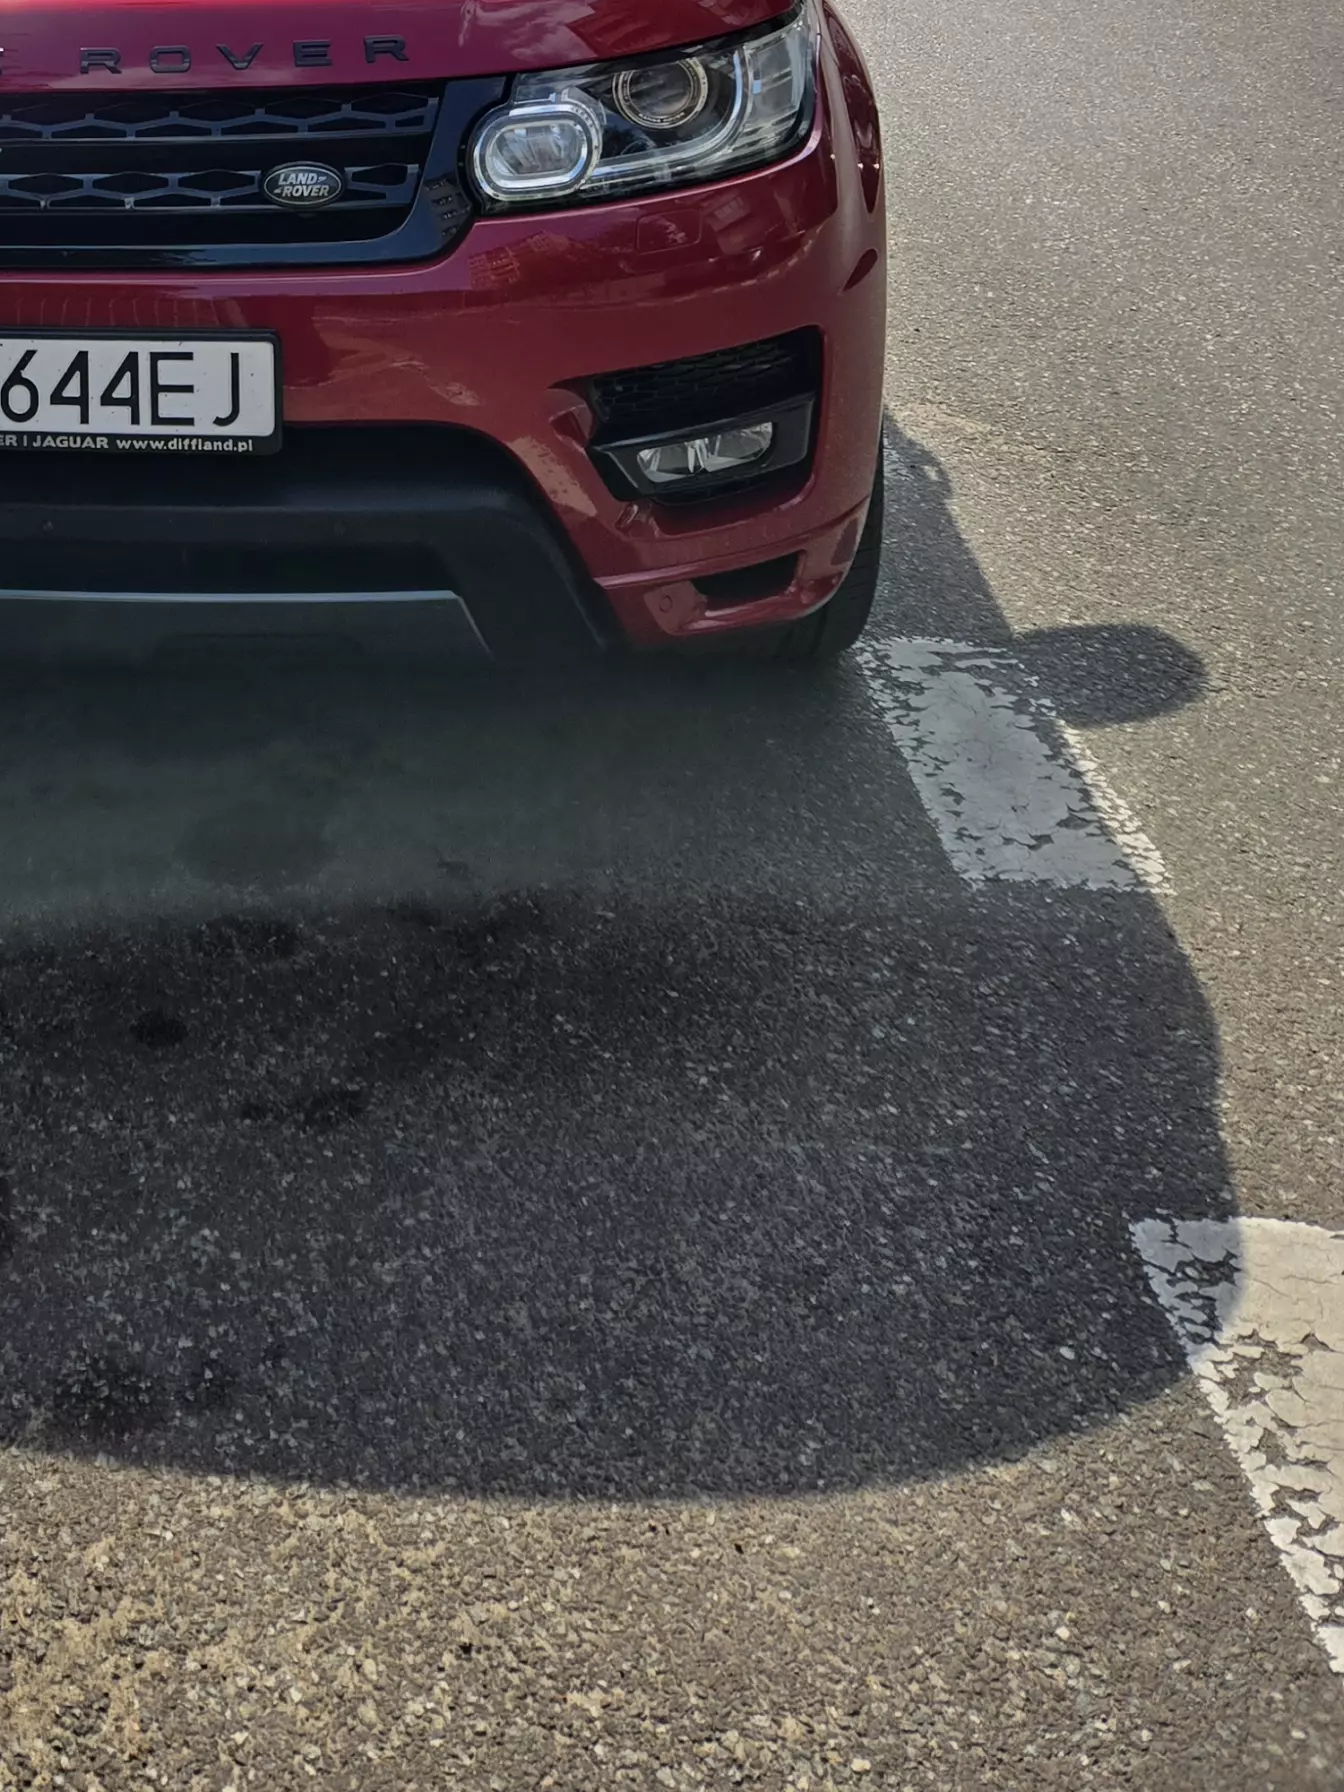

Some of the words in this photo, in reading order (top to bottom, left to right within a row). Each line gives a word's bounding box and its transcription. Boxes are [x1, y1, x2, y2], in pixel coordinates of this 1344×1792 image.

[79, 34, 410, 75] ROVER
[278, 172, 318, 185] LAND
[282, 185, 330, 197] ROVER
[0, 348, 241, 427] 644EJ
[32, 435, 109, 450] JAGUAR
[116, 438, 254, 453] www.diffland.pl
